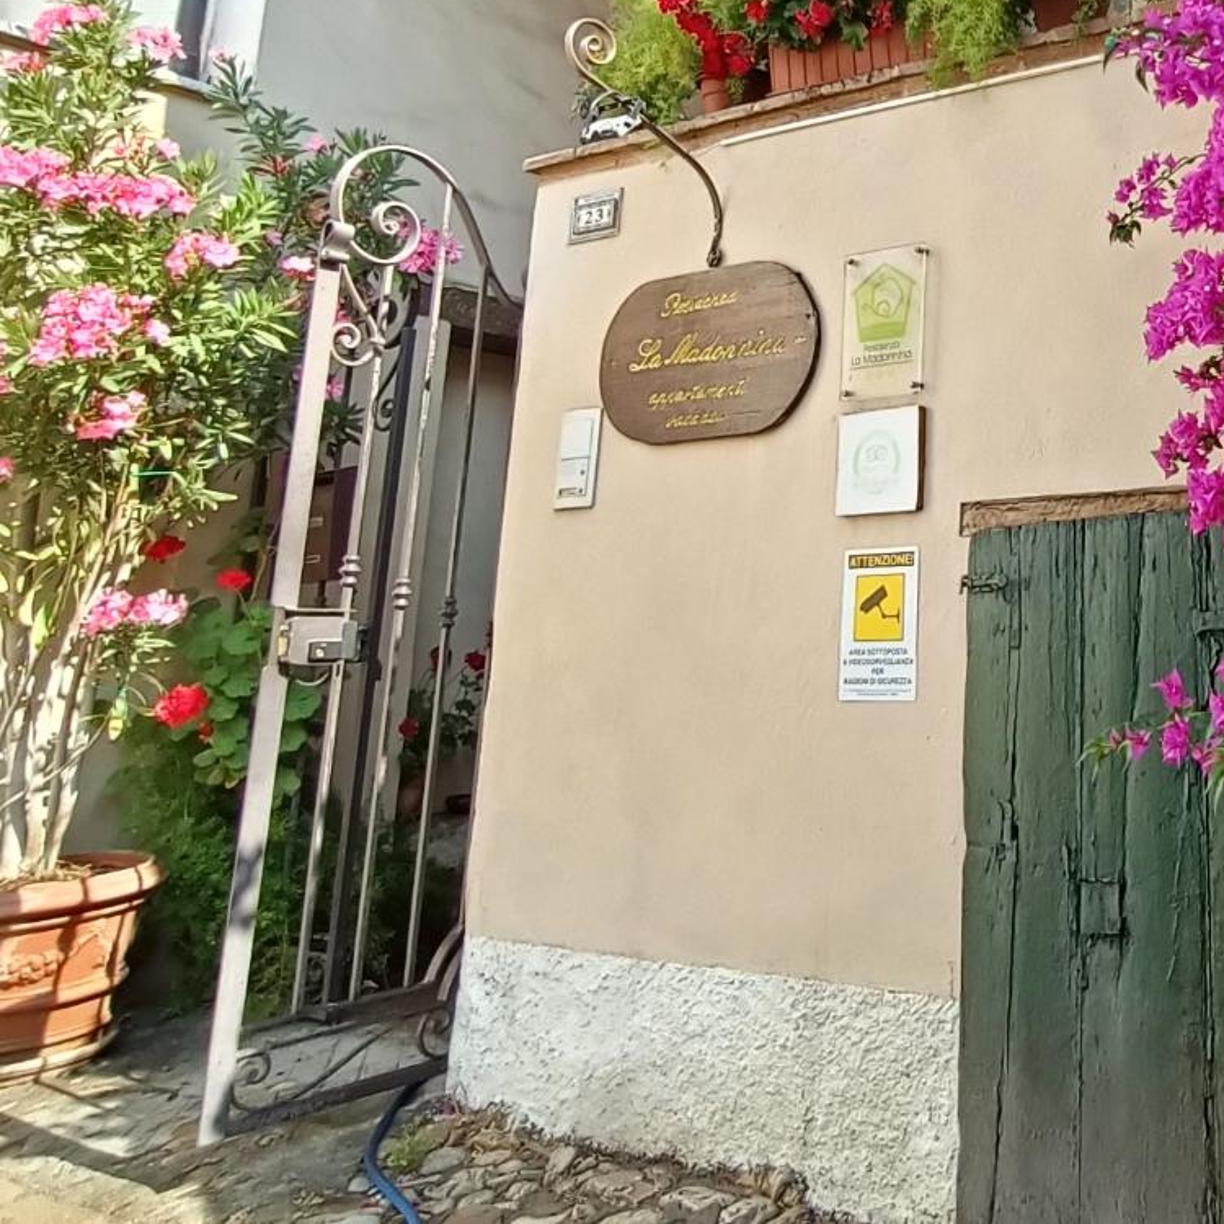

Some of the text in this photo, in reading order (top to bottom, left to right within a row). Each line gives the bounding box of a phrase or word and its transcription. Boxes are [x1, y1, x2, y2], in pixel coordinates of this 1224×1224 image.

[584, 207, 605, 225] 23
[629, 338, 663, 371] La
[850, 356, 861, 367] La
[867, 647, 908, 655] SOTTOPOSTA
[871, 667, 884, 675] PER
